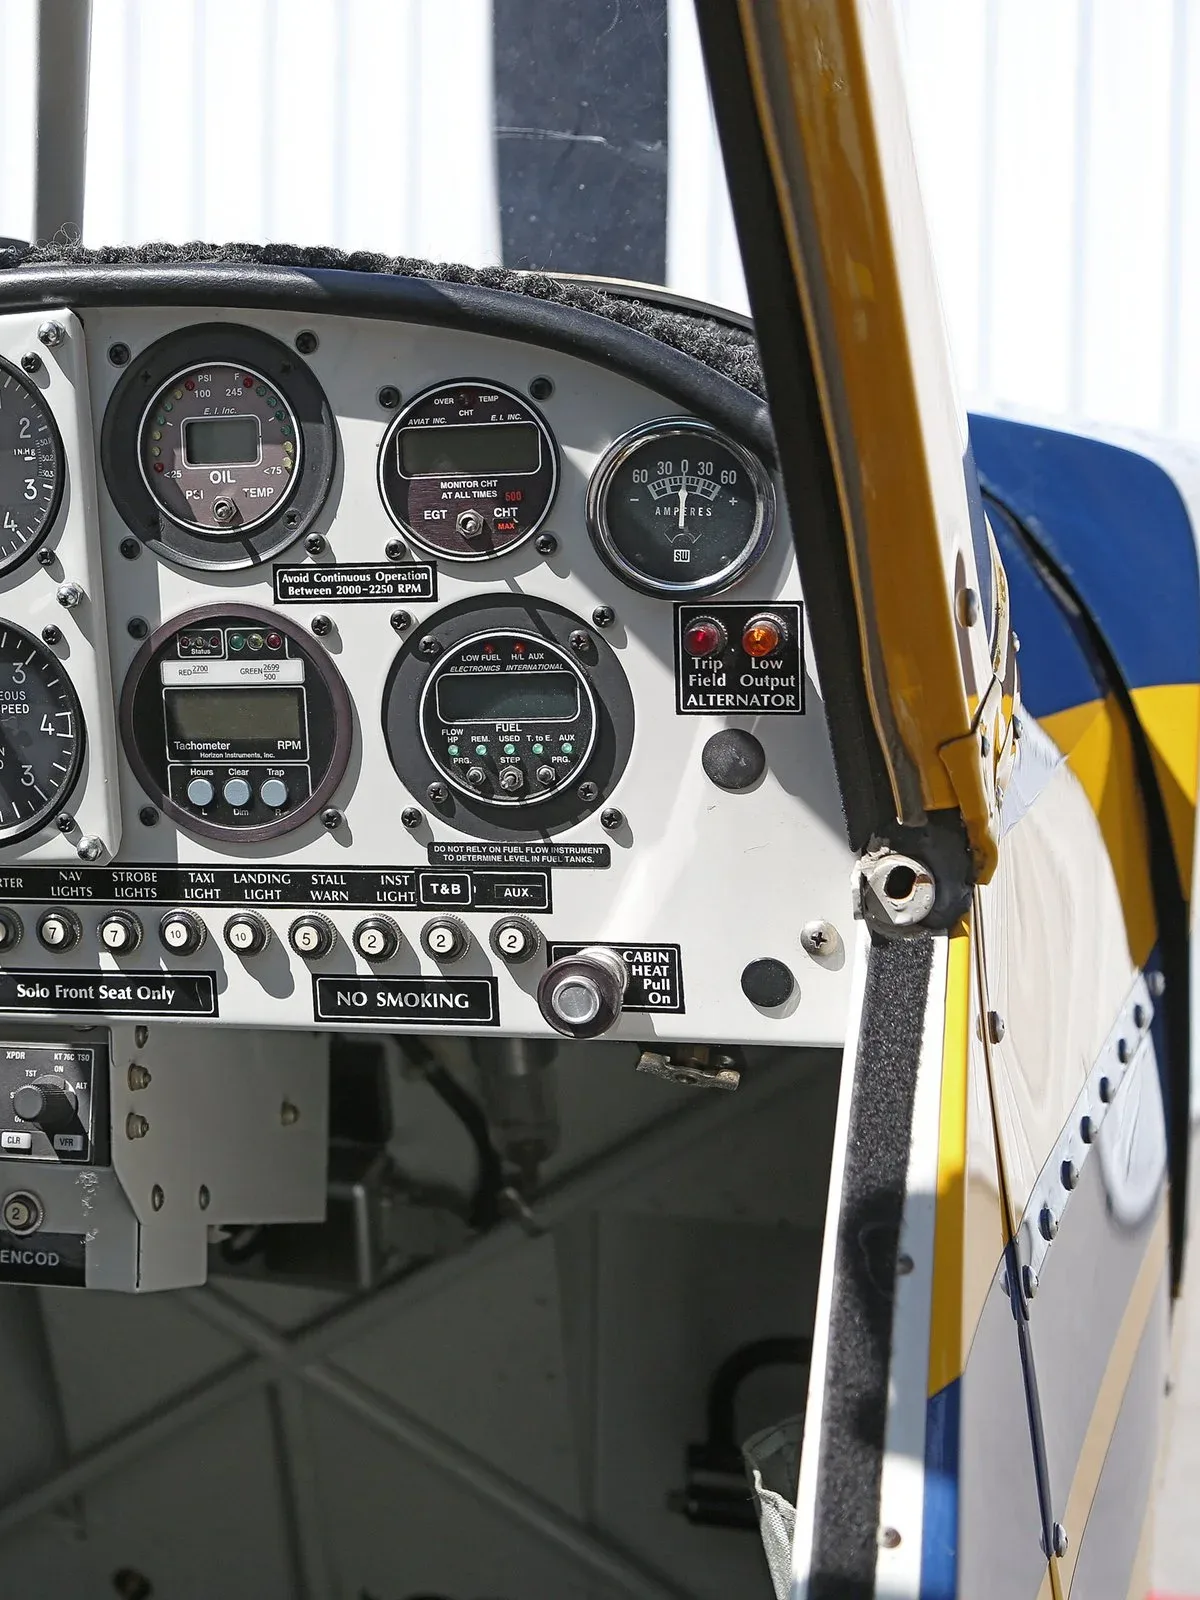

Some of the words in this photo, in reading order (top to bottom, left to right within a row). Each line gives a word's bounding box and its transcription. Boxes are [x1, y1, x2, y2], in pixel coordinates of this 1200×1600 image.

[198, 374, 212, 382] PSI
[194, 389, 211, 398] 100
[225, 388, 243, 397] 245
[433, 397, 455, 405] OVER
[478, 395, 499, 403] TEMP
[458, 409, 474, 417] CHT
[432, 417, 448, 425] INC.
[19, 417, 32, 438] 2
[208, 470, 237, 485] OIL
[632, 468, 649, 484] 60
[656, 460, 673, 475] 30
[697, 461, 714, 476] 30
[720, 469, 737, 485] 60
[24, 478, 38, 500] 3
[440, 480, 479, 490] MONITOR
[480, 479, 499, 488] CHT
[242, 487, 275, 499] TEMP
[441, 491, 453, 500] AT
[453, 491, 471, 500] ALL
[471, 490, 499, 499] TIMES
[423, 509, 448, 520] EGT
[493, 507, 519, 518] CHT
[654, 506, 713, 517] AMPERES
[497, 522, 516, 531] MAX
[281, 572, 310, 584] Avoid
[313, 571, 371, 583] Continuous
[374, 570, 429, 583] Operation
[287, 585, 333, 597] Between
[335, 584, 394, 595] 2000-2250
[397, 583, 423, 595] RPM
[461, 654, 480, 662] LOW
[480, 653, 502, 662] FUEL
[528, 652, 545, 660] AUX
[449, 664, 501, 673] ELECTRONICS
[505, 663, 564, 672] INTERNATIONAL
[691, 656, 724, 674] Trip
[751, 657, 784, 670] Low
[11, 662, 27, 684] 3
[239, 667, 263, 676] GREEN
[688, 672, 727, 687] Field
[739, 674, 796, 691] Output
[686, 693, 796, 707] ALTERNATOR
[39, 713, 56, 736] 4
[495, 723, 523, 733] FUEL
[498, 735, 521, 743] USED
[558, 734, 576, 742] AUX
[173, 740, 231, 751] Tachometer
[277, 740, 303, 750] RPM
[199, 751, 224, 759] Horizon
[499, 757, 521, 765] STEP
[189, 768, 215, 777] Hours
[228, 768, 250, 777] Clear
[266, 768, 286, 778] Trap
[433, 845, 446, 853] DO
[447, 845, 465, 853] NOT
[466, 845, 488, 854] RELY
[488, 845, 502, 854] ON
[502, 845, 524, 854] FUEL
[525, 846, 550, 854] FLOW
[550, 846, 604, 855] INSTRUMENT
[443, 854, 456, 862] TO
[456, 854, 503, 862] DETERMINE
[503, 854, 530, 863] LEVEL
[531, 854, 541, 863] IN
[541, 855, 563, 863] FUEL
[564, 855, 596, 864] TANKS.
[58, 871, 83, 881] NAV
[111, 871, 158, 883] STROBE
[188, 873, 215, 884] TAXI
[233, 873, 292, 885] LANDING
[311, 874, 347, 885] STALL
[380, 874, 410, 886] INST
[50, 886, 93, 897] LIGHTS
[114, 887, 158, 899] LIGHTS
[183, 888, 222, 900] LIGHT
[244, 889, 283, 901] LIGHT
[430, 883, 461, 895] T&B
[503, 887, 534, 899] AUX.
[310, 890, 350, 901] WARN
[376, 890, 416, 902] LIGHT
[170, 929, 182, 940] 10
[235, 932, 247, 943] 10
[622, 950, 670, 964] CABIN
[631, 964, 670, 977] HEAT
[643, 978, 671, 992] Pull
[16, 983, 50, 999] Solo
[55, 985, 95, 1000] Front
[99, 984, 133, 1000] Seat
[136, 985, 176, 1005] Only
[336, 991, 368, 1007] NO
[376, 992, 470, 1009] SMOKING
[648, 992, 671, 1005] On
[5, 1051, 26, 1061] XPDR
[0, 1249, 60, 1268] ENCOD
